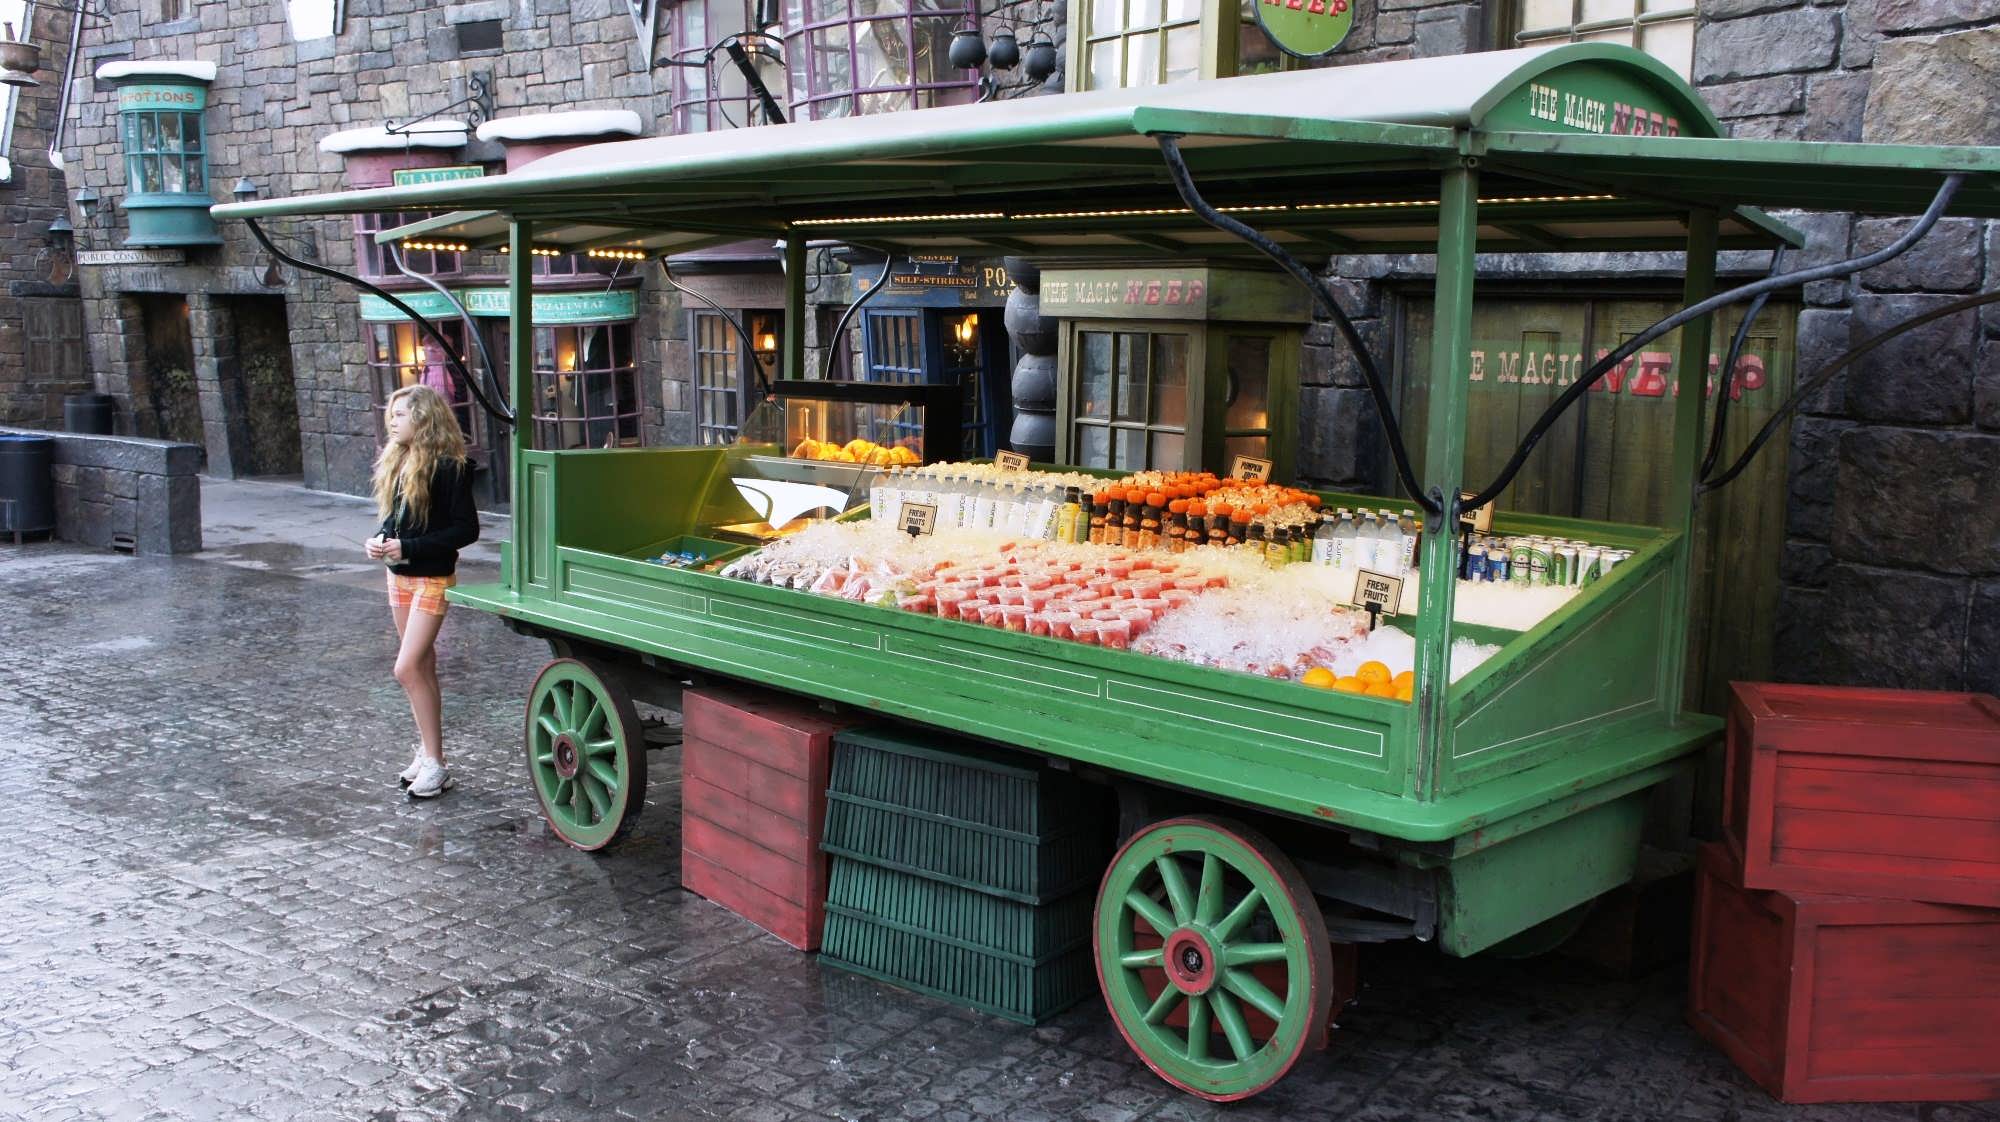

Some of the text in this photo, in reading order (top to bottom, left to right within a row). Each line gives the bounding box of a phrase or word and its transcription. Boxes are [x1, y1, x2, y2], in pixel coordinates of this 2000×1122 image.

[1530, 83, 1558, 122] THE
[1563, 93, 1606, 133] MAGIC
[894, 275, 975, 285] SELF-STIRRING
[1042, 279, 1205, 305] THE MAGIC NEEP
[1498, 352, 1583, 386] MAGIC
[909, 509, 927, 518] FRESH
[906, 517, 926, 527] FRUITS
[1366, 579, 1390, 593] FRESH
[1363, 589, 1389, 603] FRUITS
